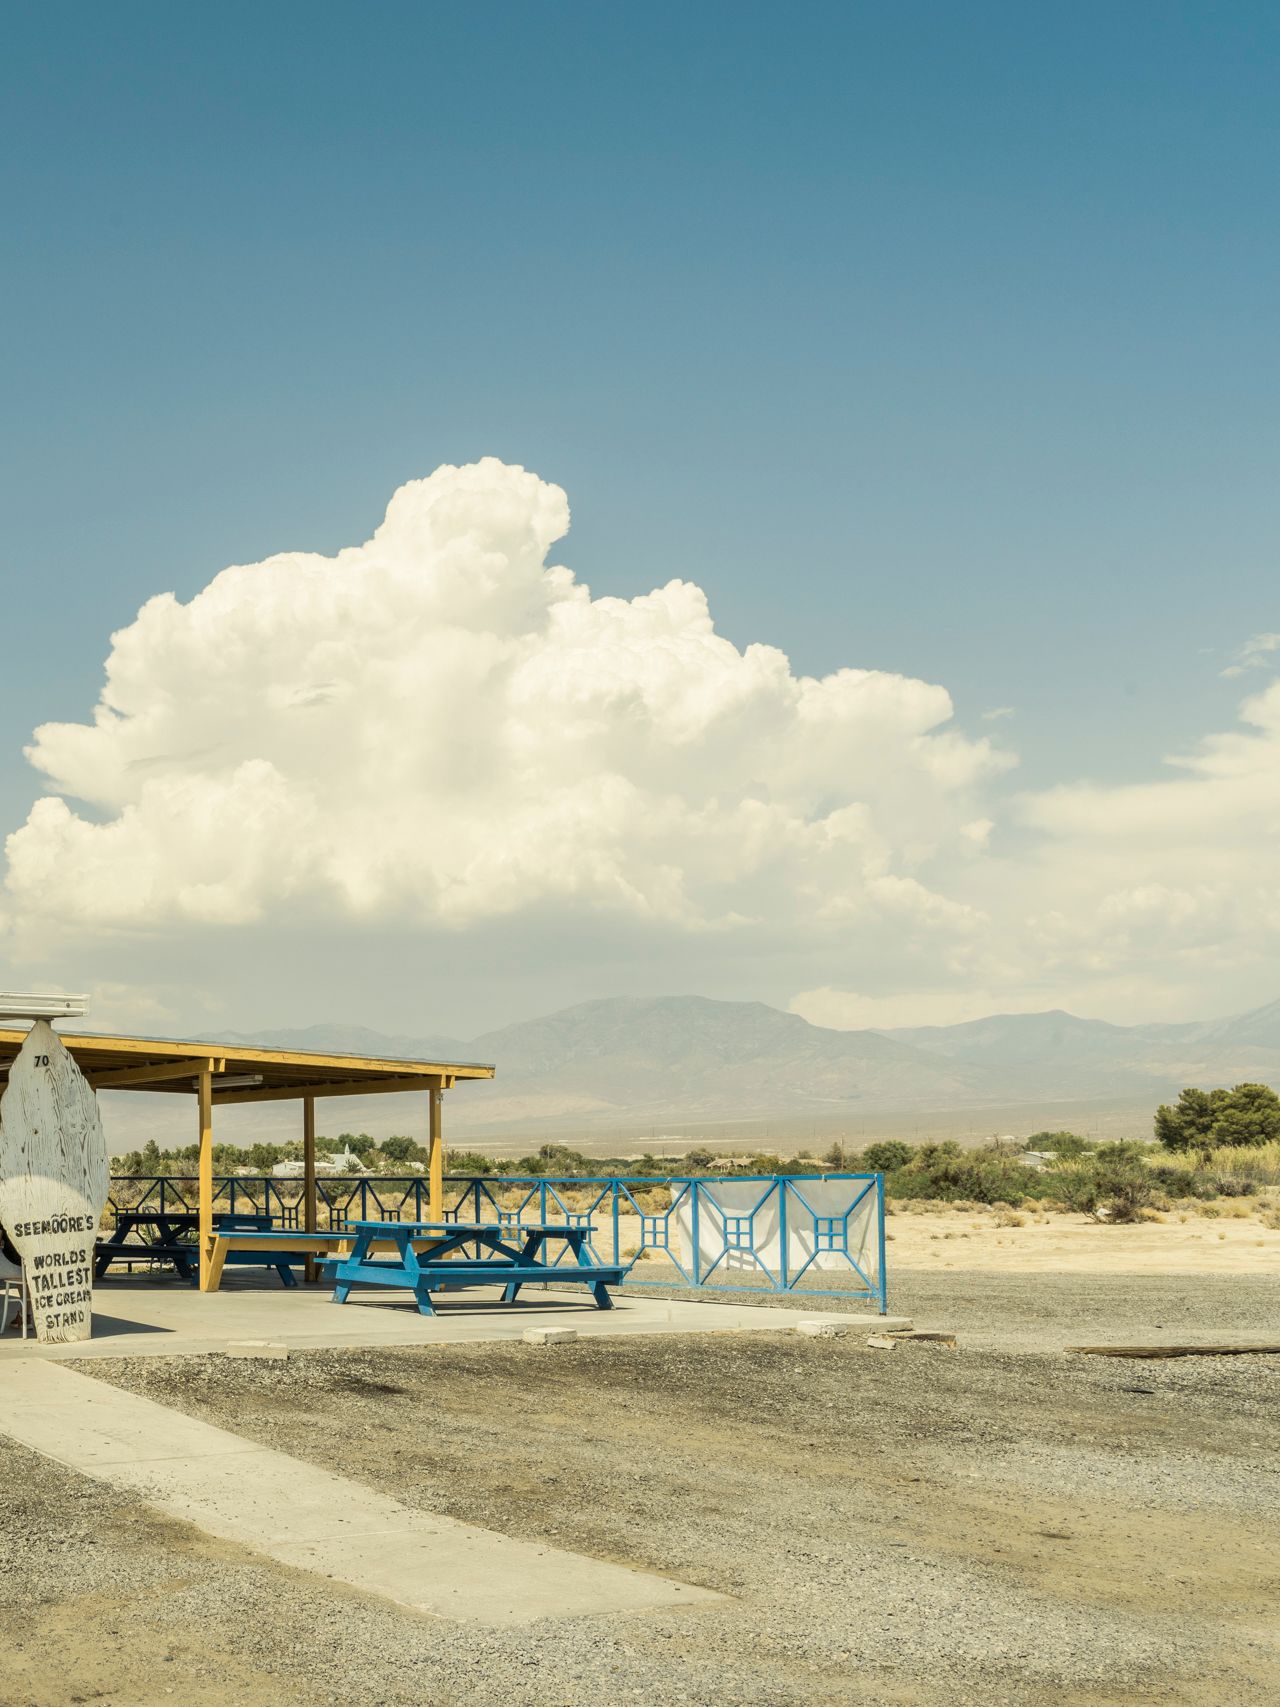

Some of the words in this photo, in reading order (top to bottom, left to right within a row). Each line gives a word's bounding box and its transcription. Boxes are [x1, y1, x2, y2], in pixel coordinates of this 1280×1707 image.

[34, 1055, 49, 1067] 70
[33, 1249, 87, 1270] WORLDS
[31, 1267, 91, 1293] TALLEST
[35, 1295, 54, 1310] ICE
[56, 1289, 91, 1307] CREAM
[45, 1310, 85, 1329] STAND
